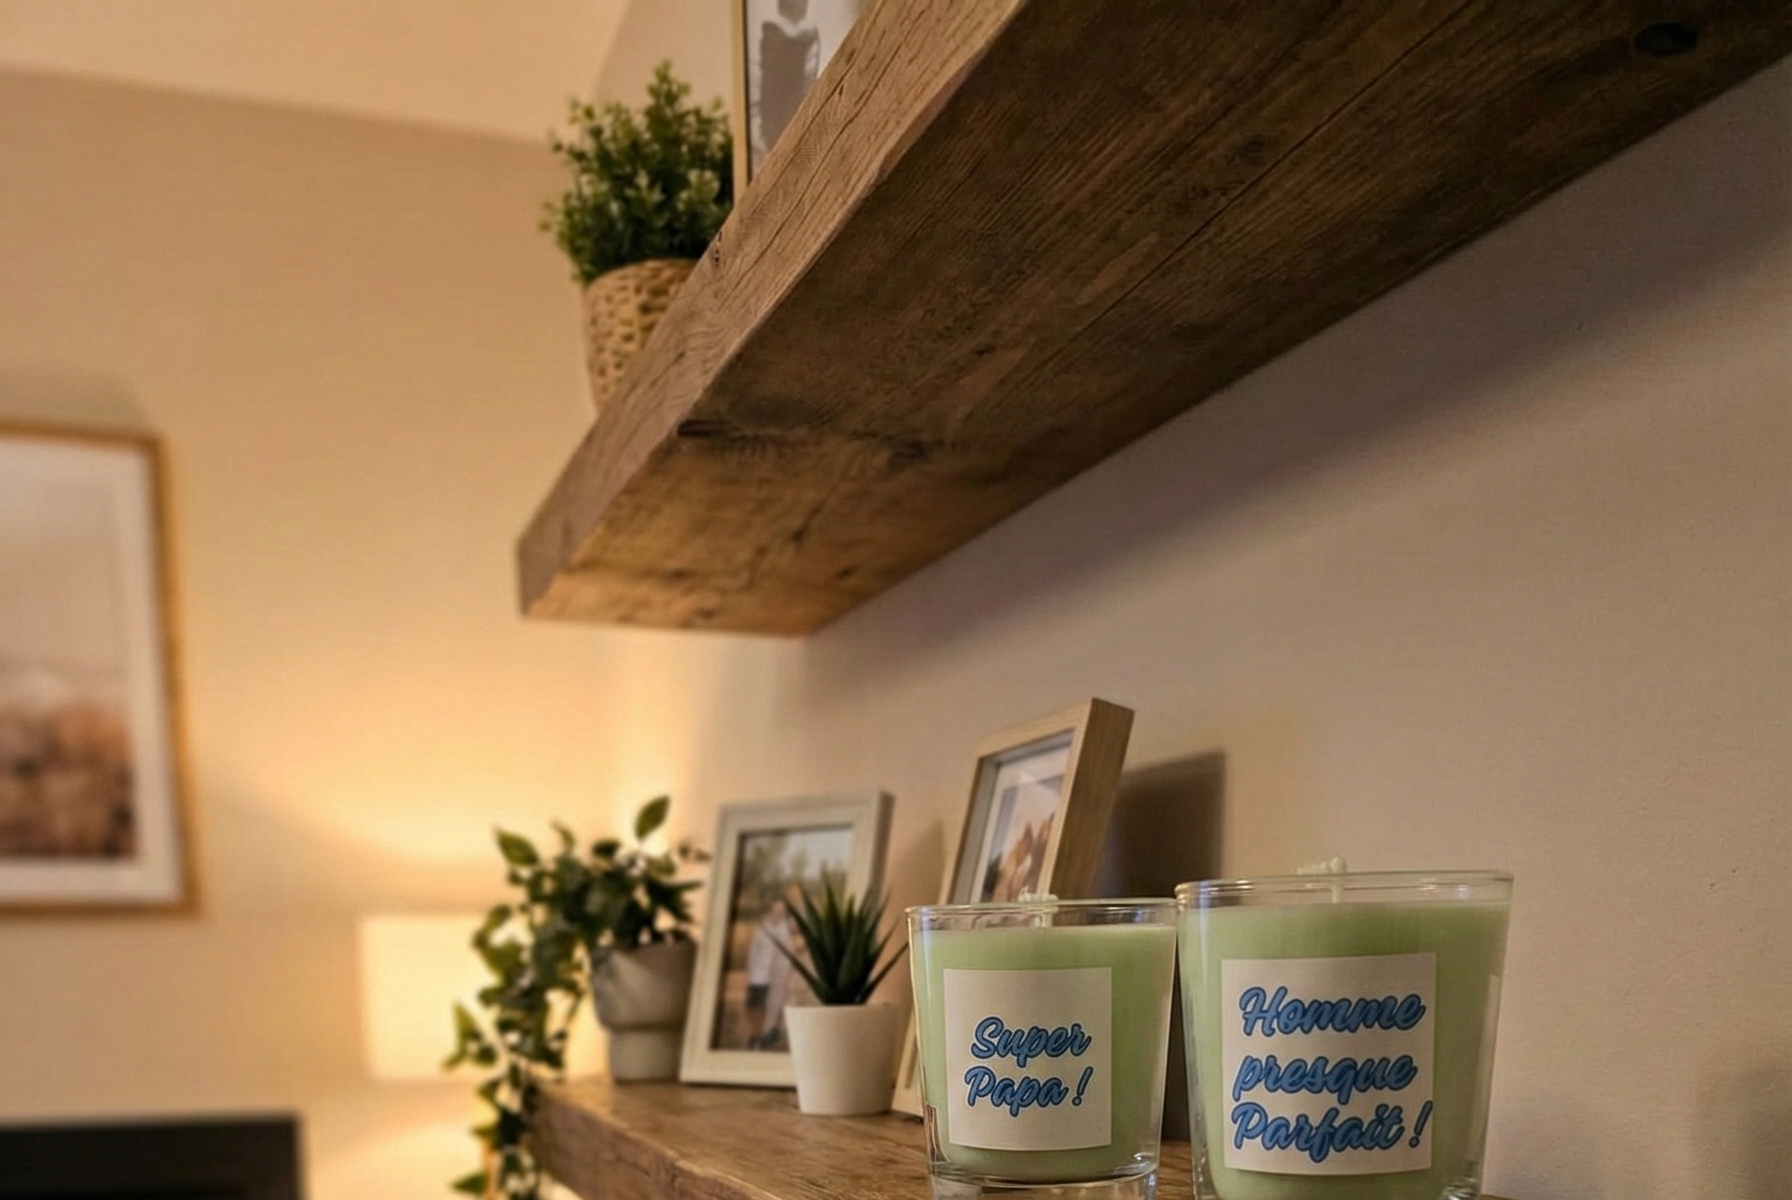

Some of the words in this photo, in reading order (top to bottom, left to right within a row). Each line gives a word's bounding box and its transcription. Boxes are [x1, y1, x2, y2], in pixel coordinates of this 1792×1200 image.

[1239, 986, 1426, 1037] Homme
[971, 1016, 1092, 1068] Super
[1232, 1054, 1418, 1105] presque
